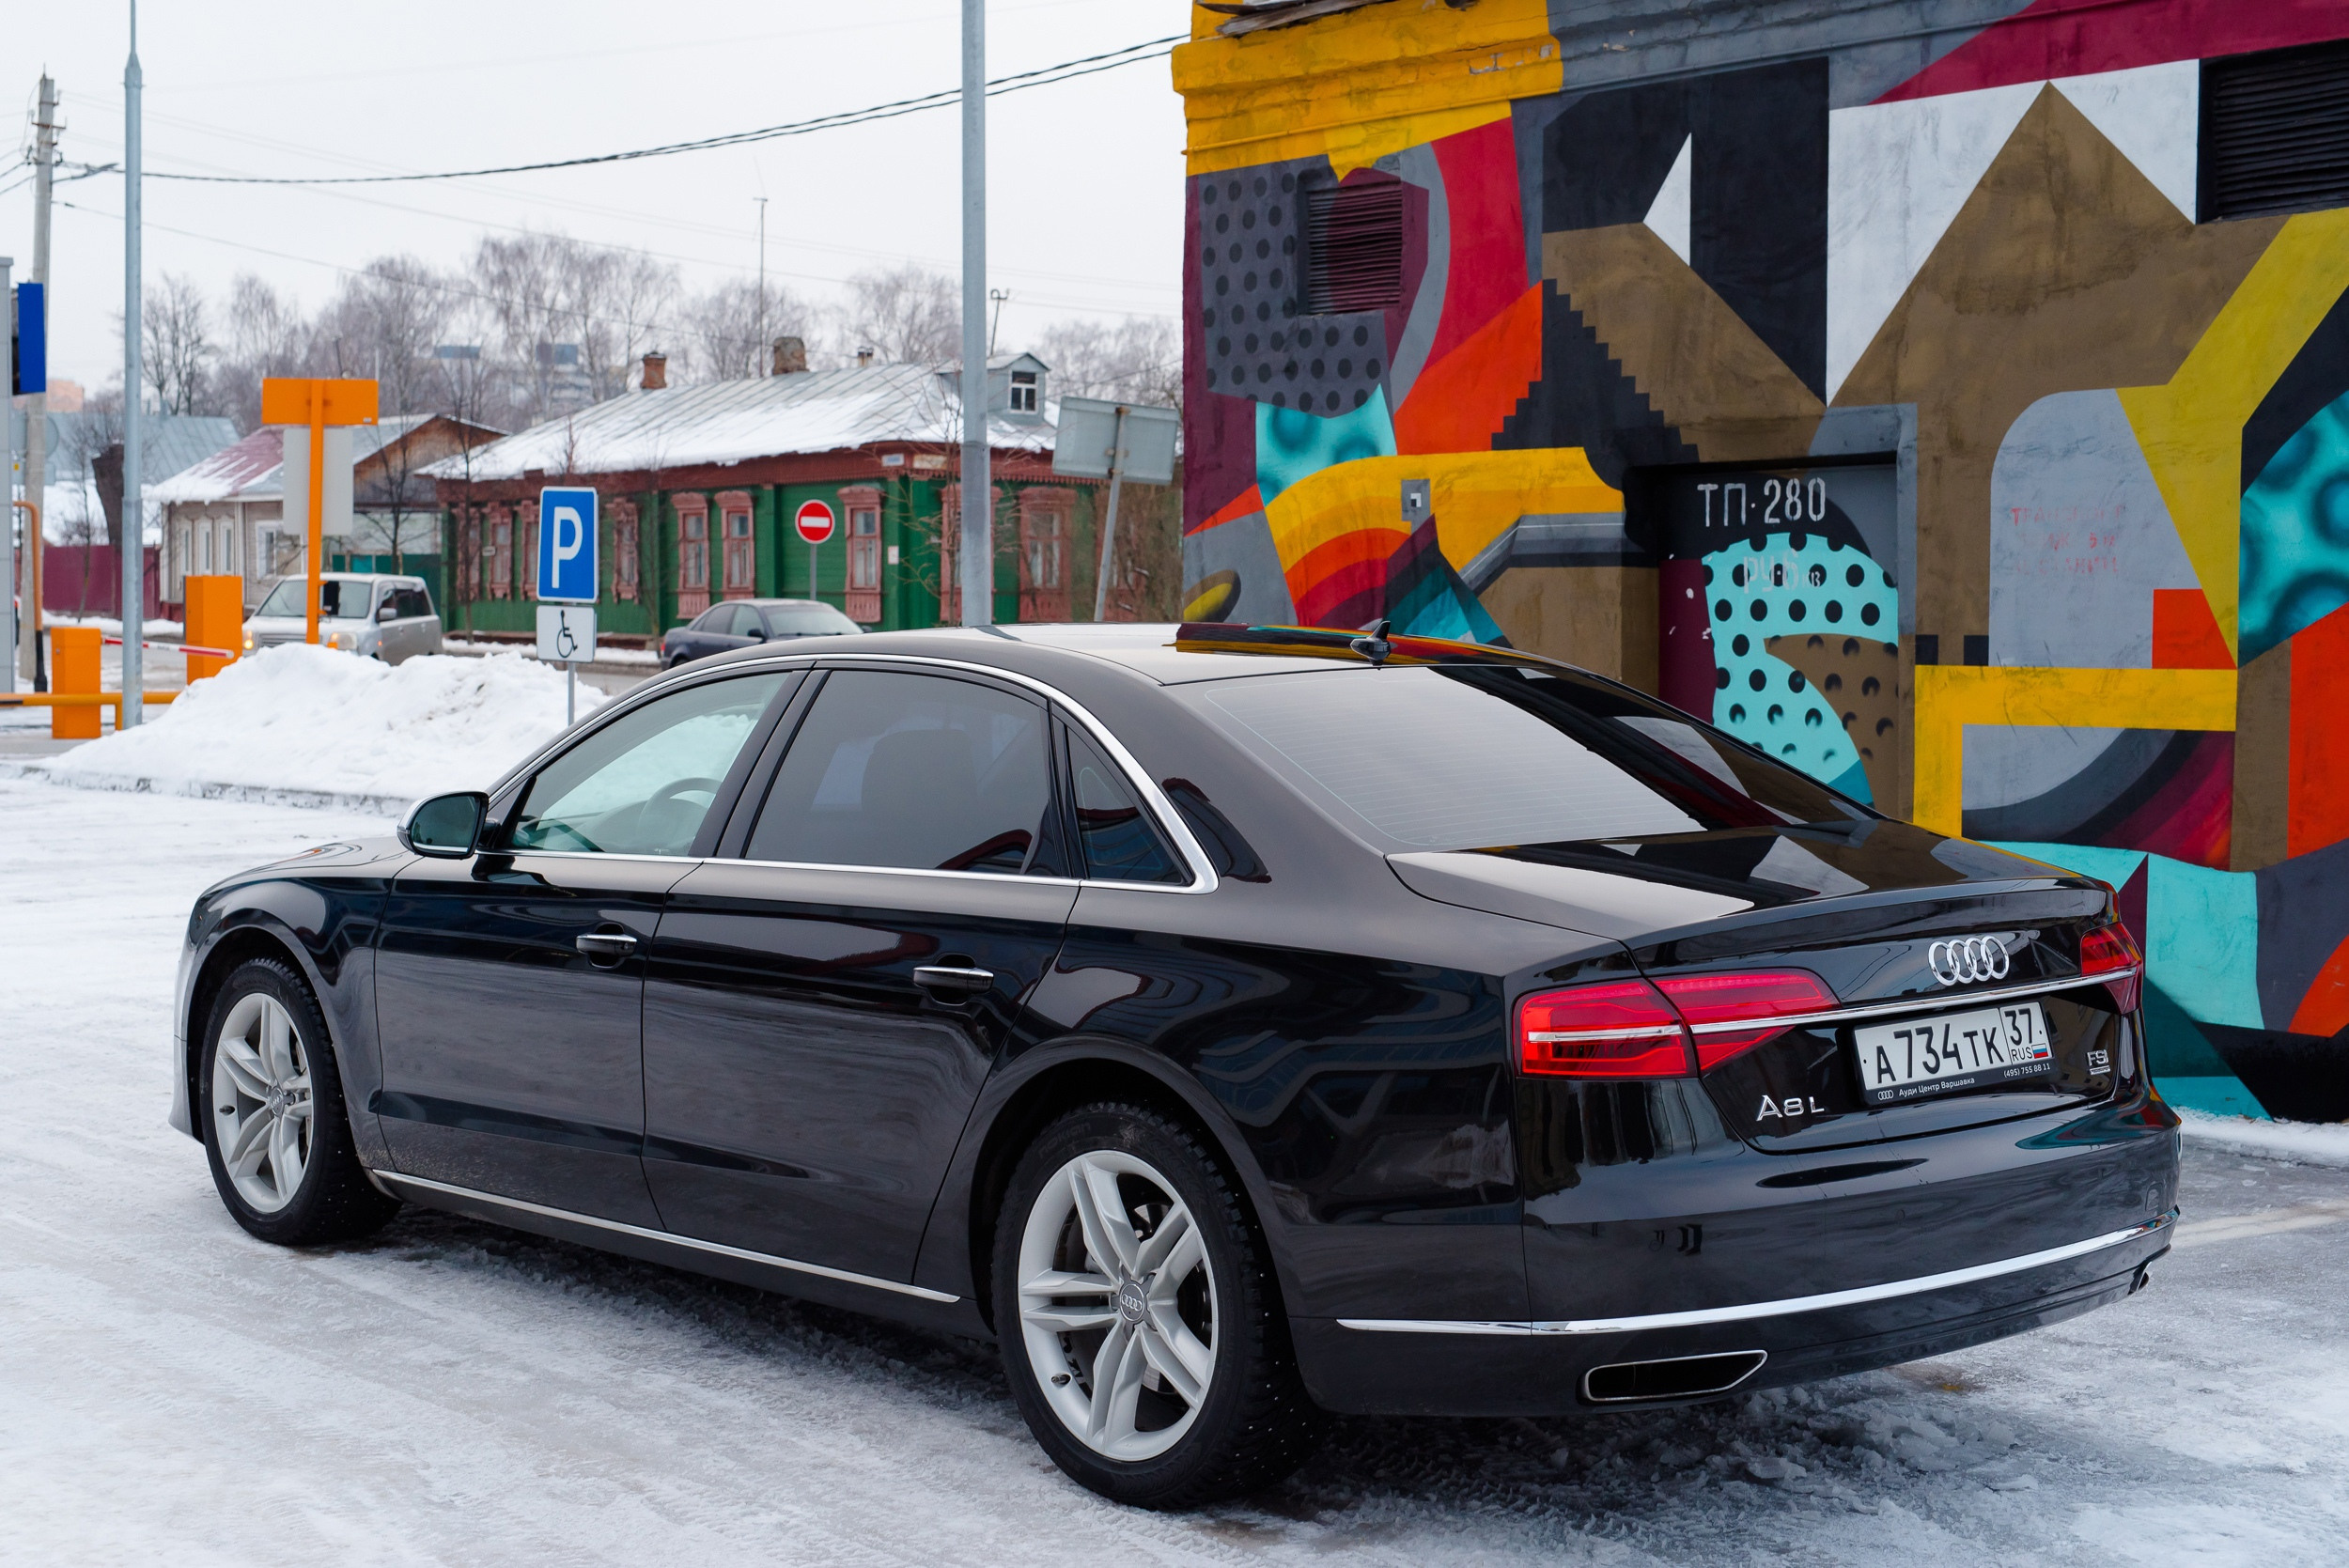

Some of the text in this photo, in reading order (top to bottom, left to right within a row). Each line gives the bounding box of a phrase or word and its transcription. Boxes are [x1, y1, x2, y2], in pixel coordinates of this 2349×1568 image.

[552, 506, 583, 589] P
[2004, 1007, 2033, 1047] 37
[2010, 1047, 2033, 1063] RUS
[2003, 1063, 2051, 1079] (495) 755 88 11
[1898, 1077, 1975, 1098] Ауди Центр Варшавка
